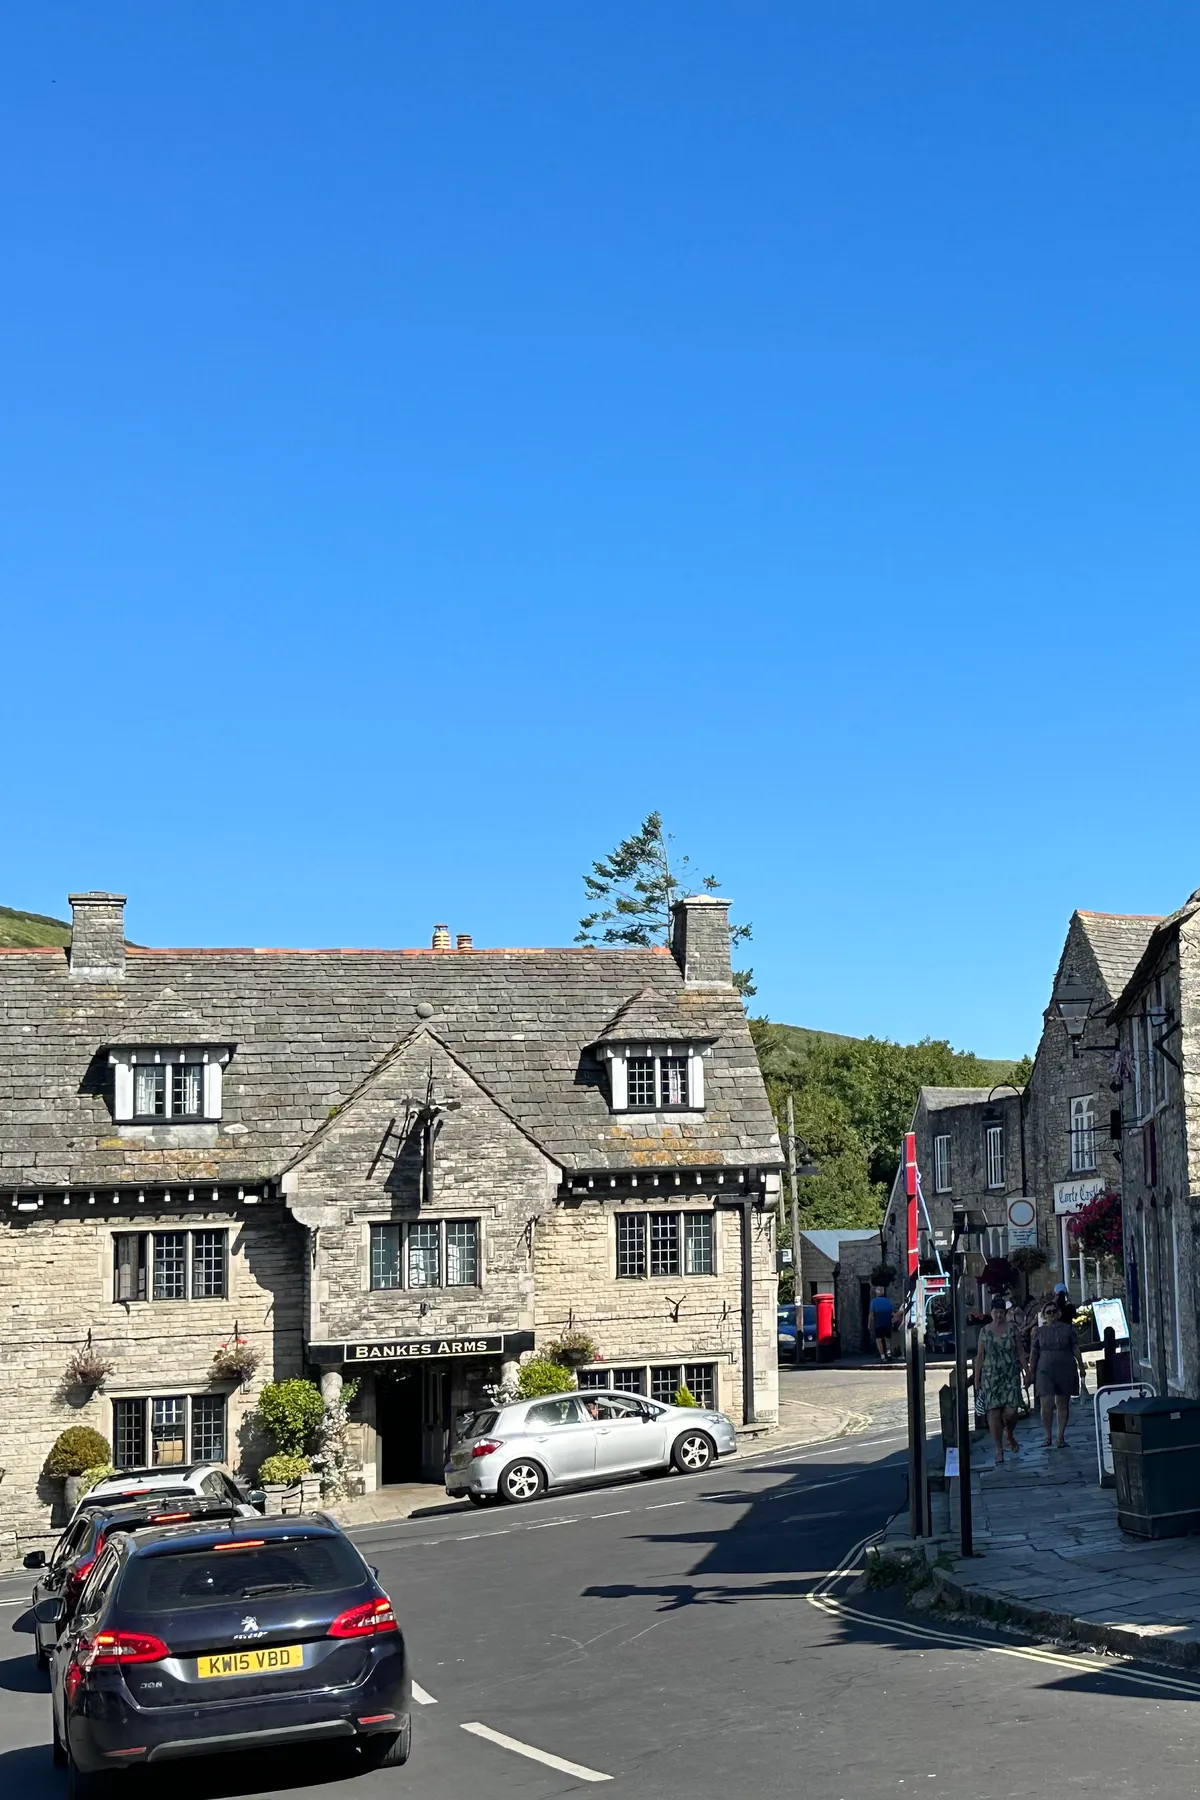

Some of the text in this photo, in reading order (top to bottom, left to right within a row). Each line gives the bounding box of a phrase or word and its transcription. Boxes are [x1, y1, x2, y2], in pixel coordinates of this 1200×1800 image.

[355, 1340, 488, 1358] BANKES ARMS
[209, 1650, 290, 1674] KW15 VBD
